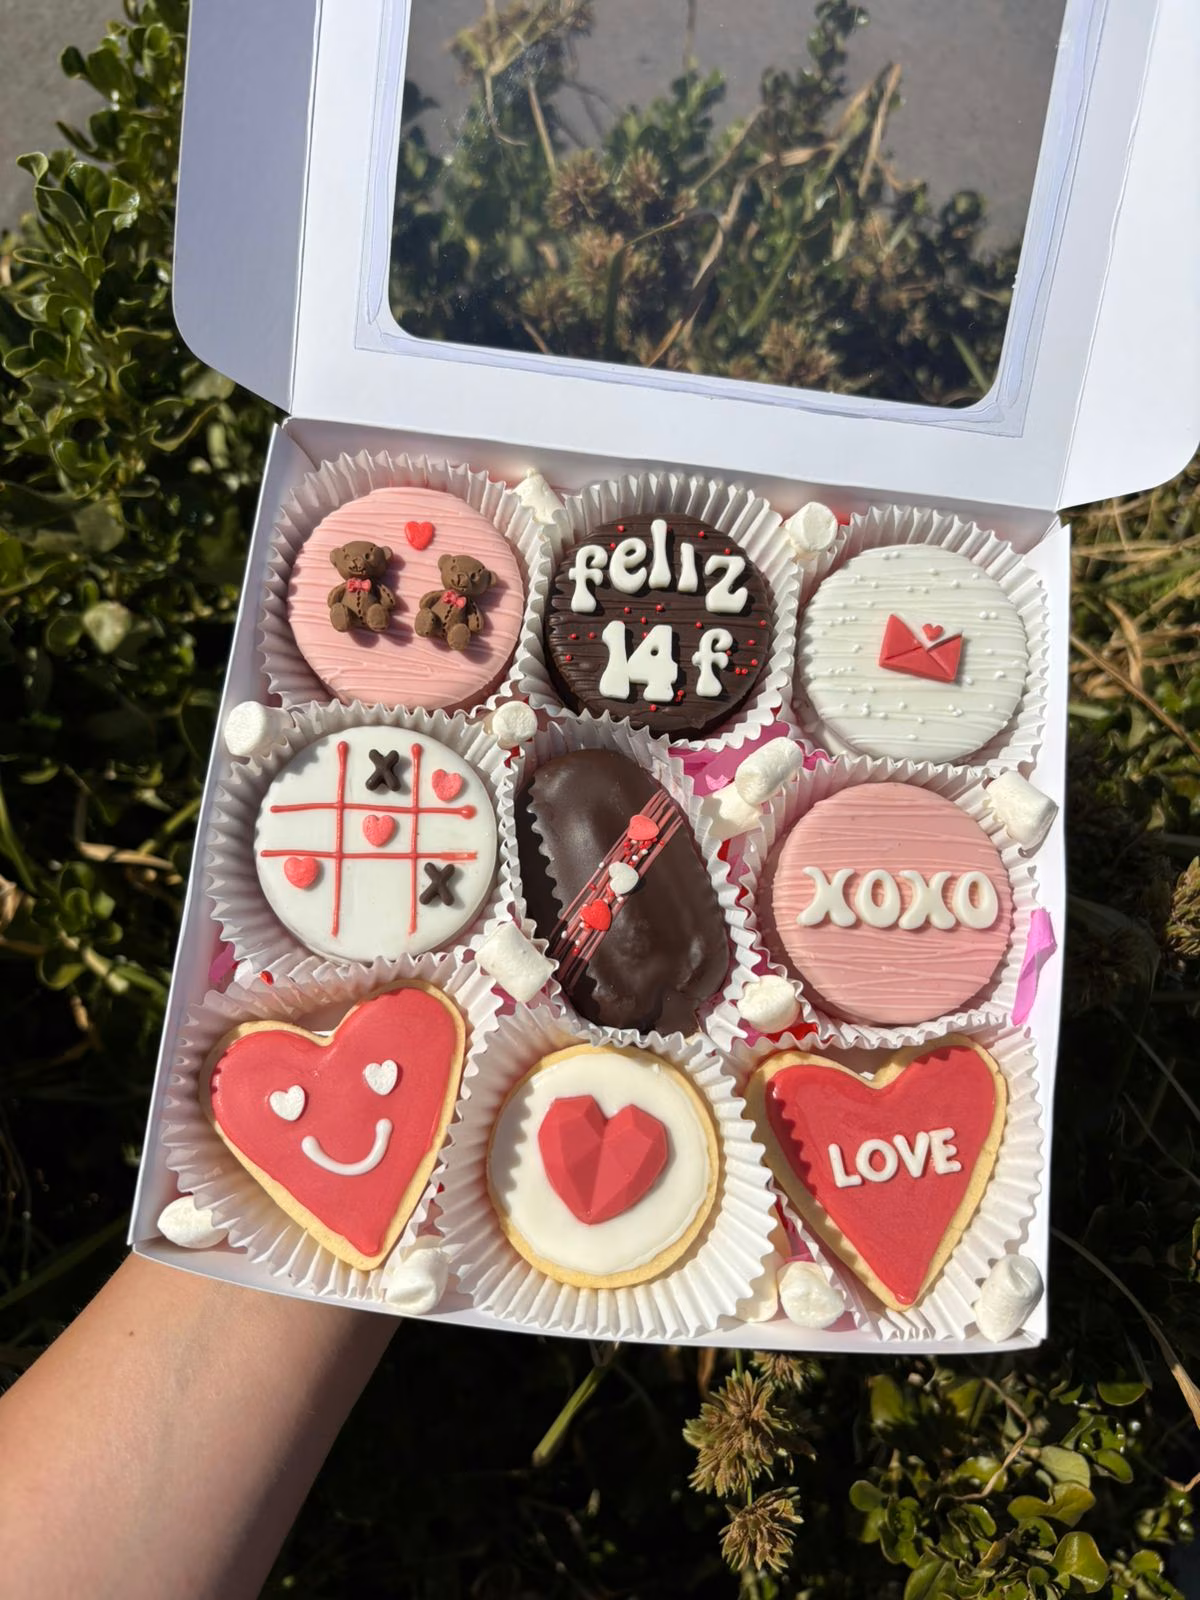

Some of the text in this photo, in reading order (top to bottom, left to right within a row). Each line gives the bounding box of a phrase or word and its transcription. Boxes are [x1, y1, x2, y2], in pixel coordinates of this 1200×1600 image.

[568, 519, 748, 613] feliz
[599, 620, 733, 702] 14 f
[796, 866, 998, 930] XOXO
[828, 1128, 962, 1188] LOVE
